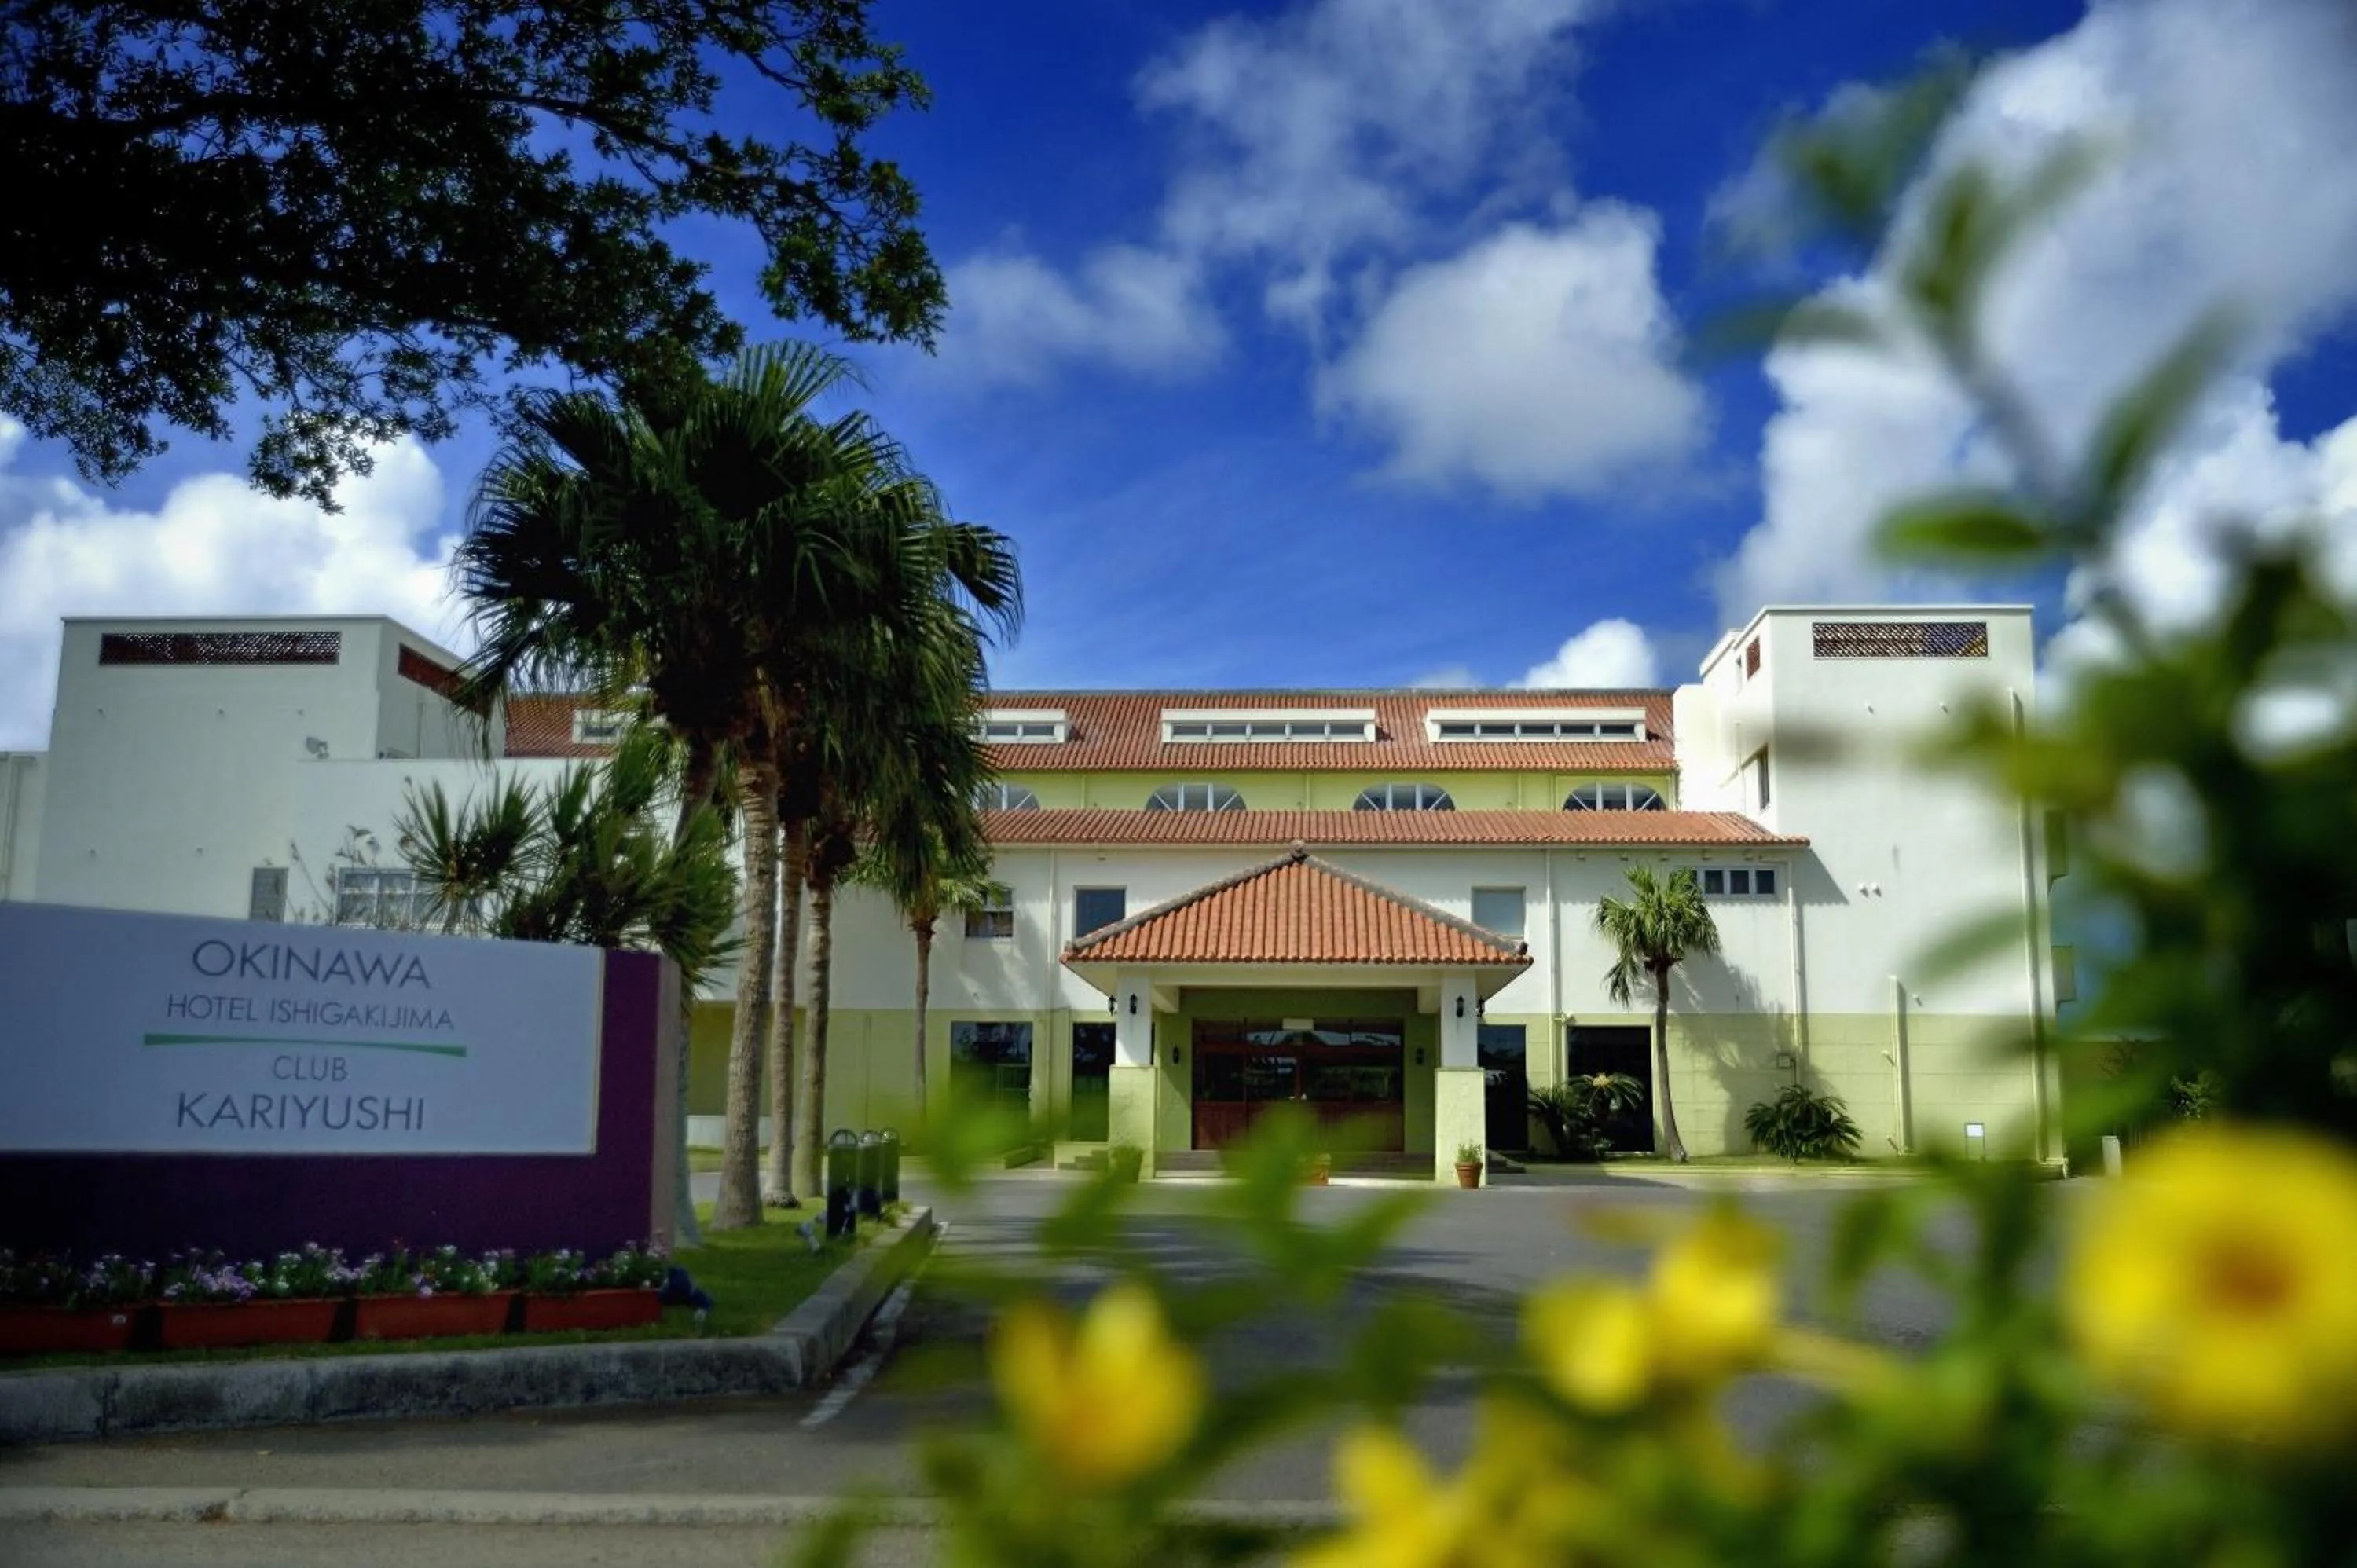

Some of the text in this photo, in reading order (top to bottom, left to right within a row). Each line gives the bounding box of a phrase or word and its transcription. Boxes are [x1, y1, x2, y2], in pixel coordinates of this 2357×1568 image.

[192, 940, 431, 989] OKINAWA
[167, 993, 455, 1030] HOTEL ISHIGAKIJIMA
[273, 1055, 349, 1082] CLUB
[177, 1091, 425, 1131] KARIYUSHI
